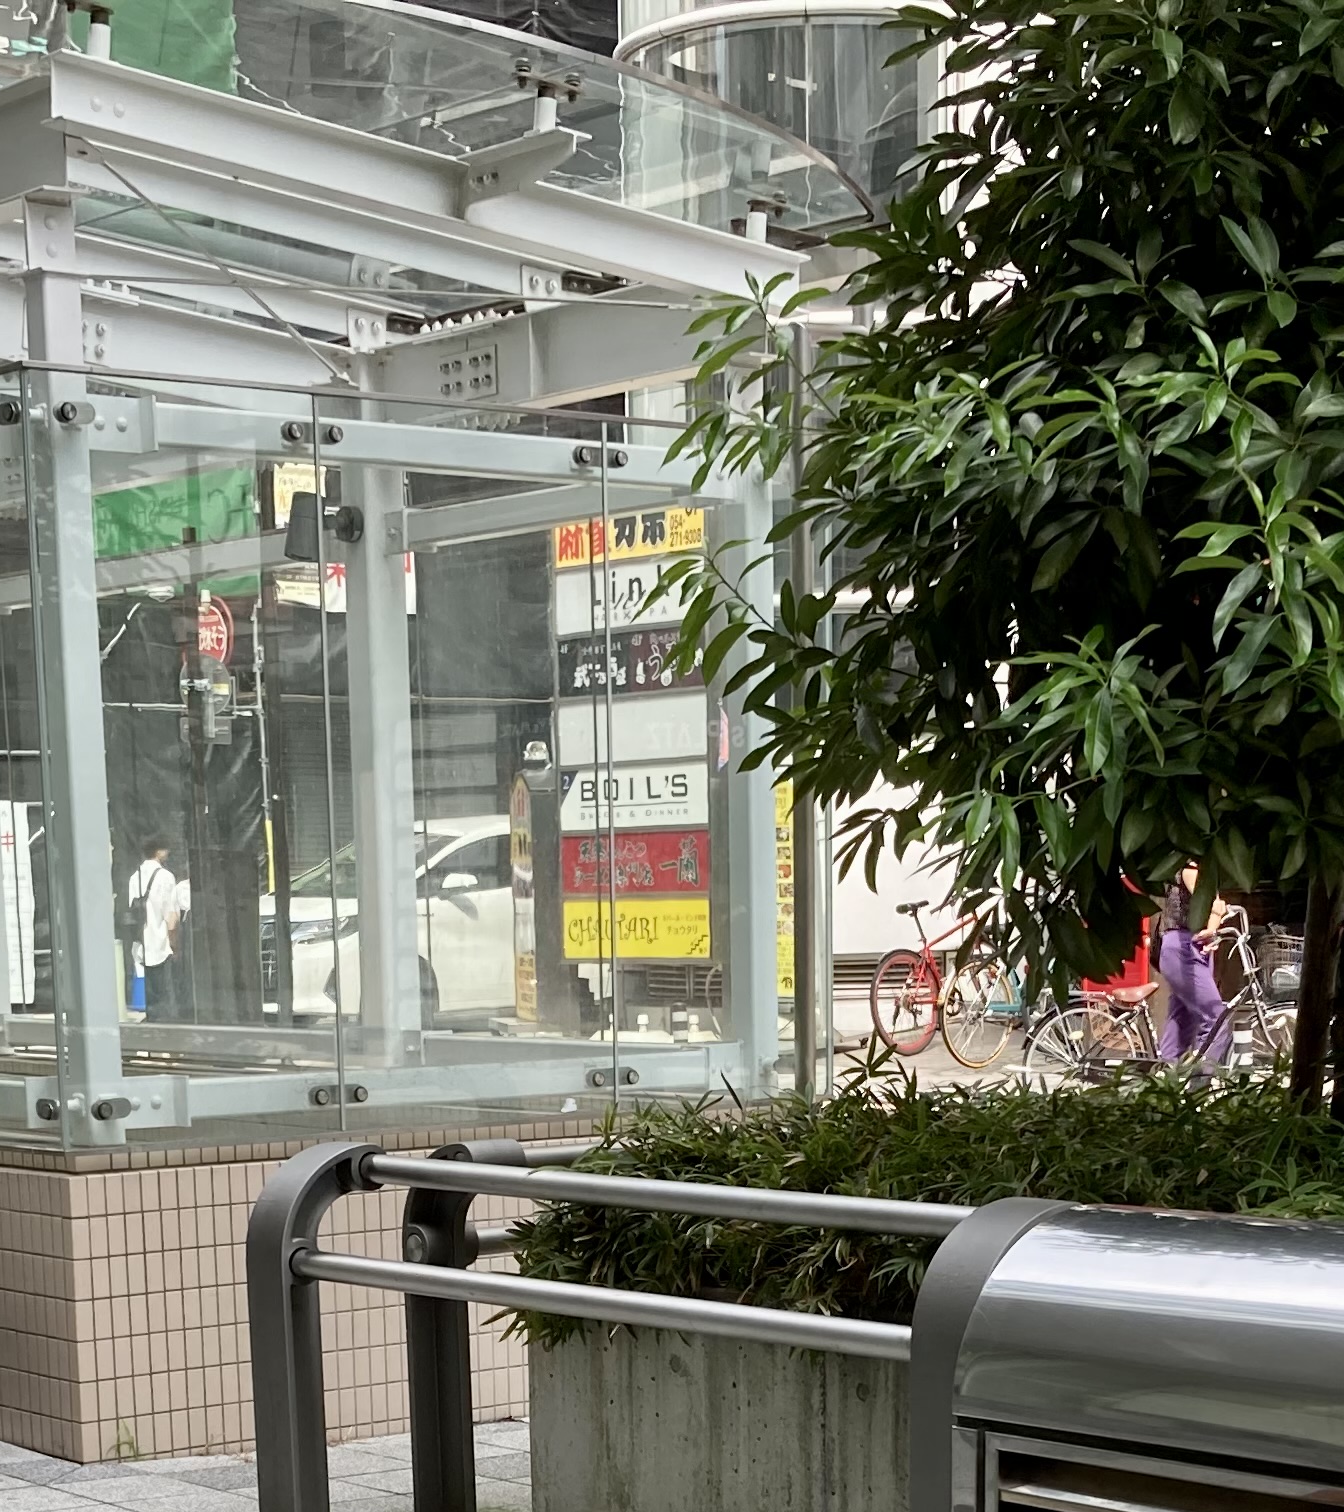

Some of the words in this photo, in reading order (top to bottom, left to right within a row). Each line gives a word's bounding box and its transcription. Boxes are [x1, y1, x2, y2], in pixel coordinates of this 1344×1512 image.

[581, 773, 688, 802] BOIL'S
[667, 923, 698, 935] チョウタリ
